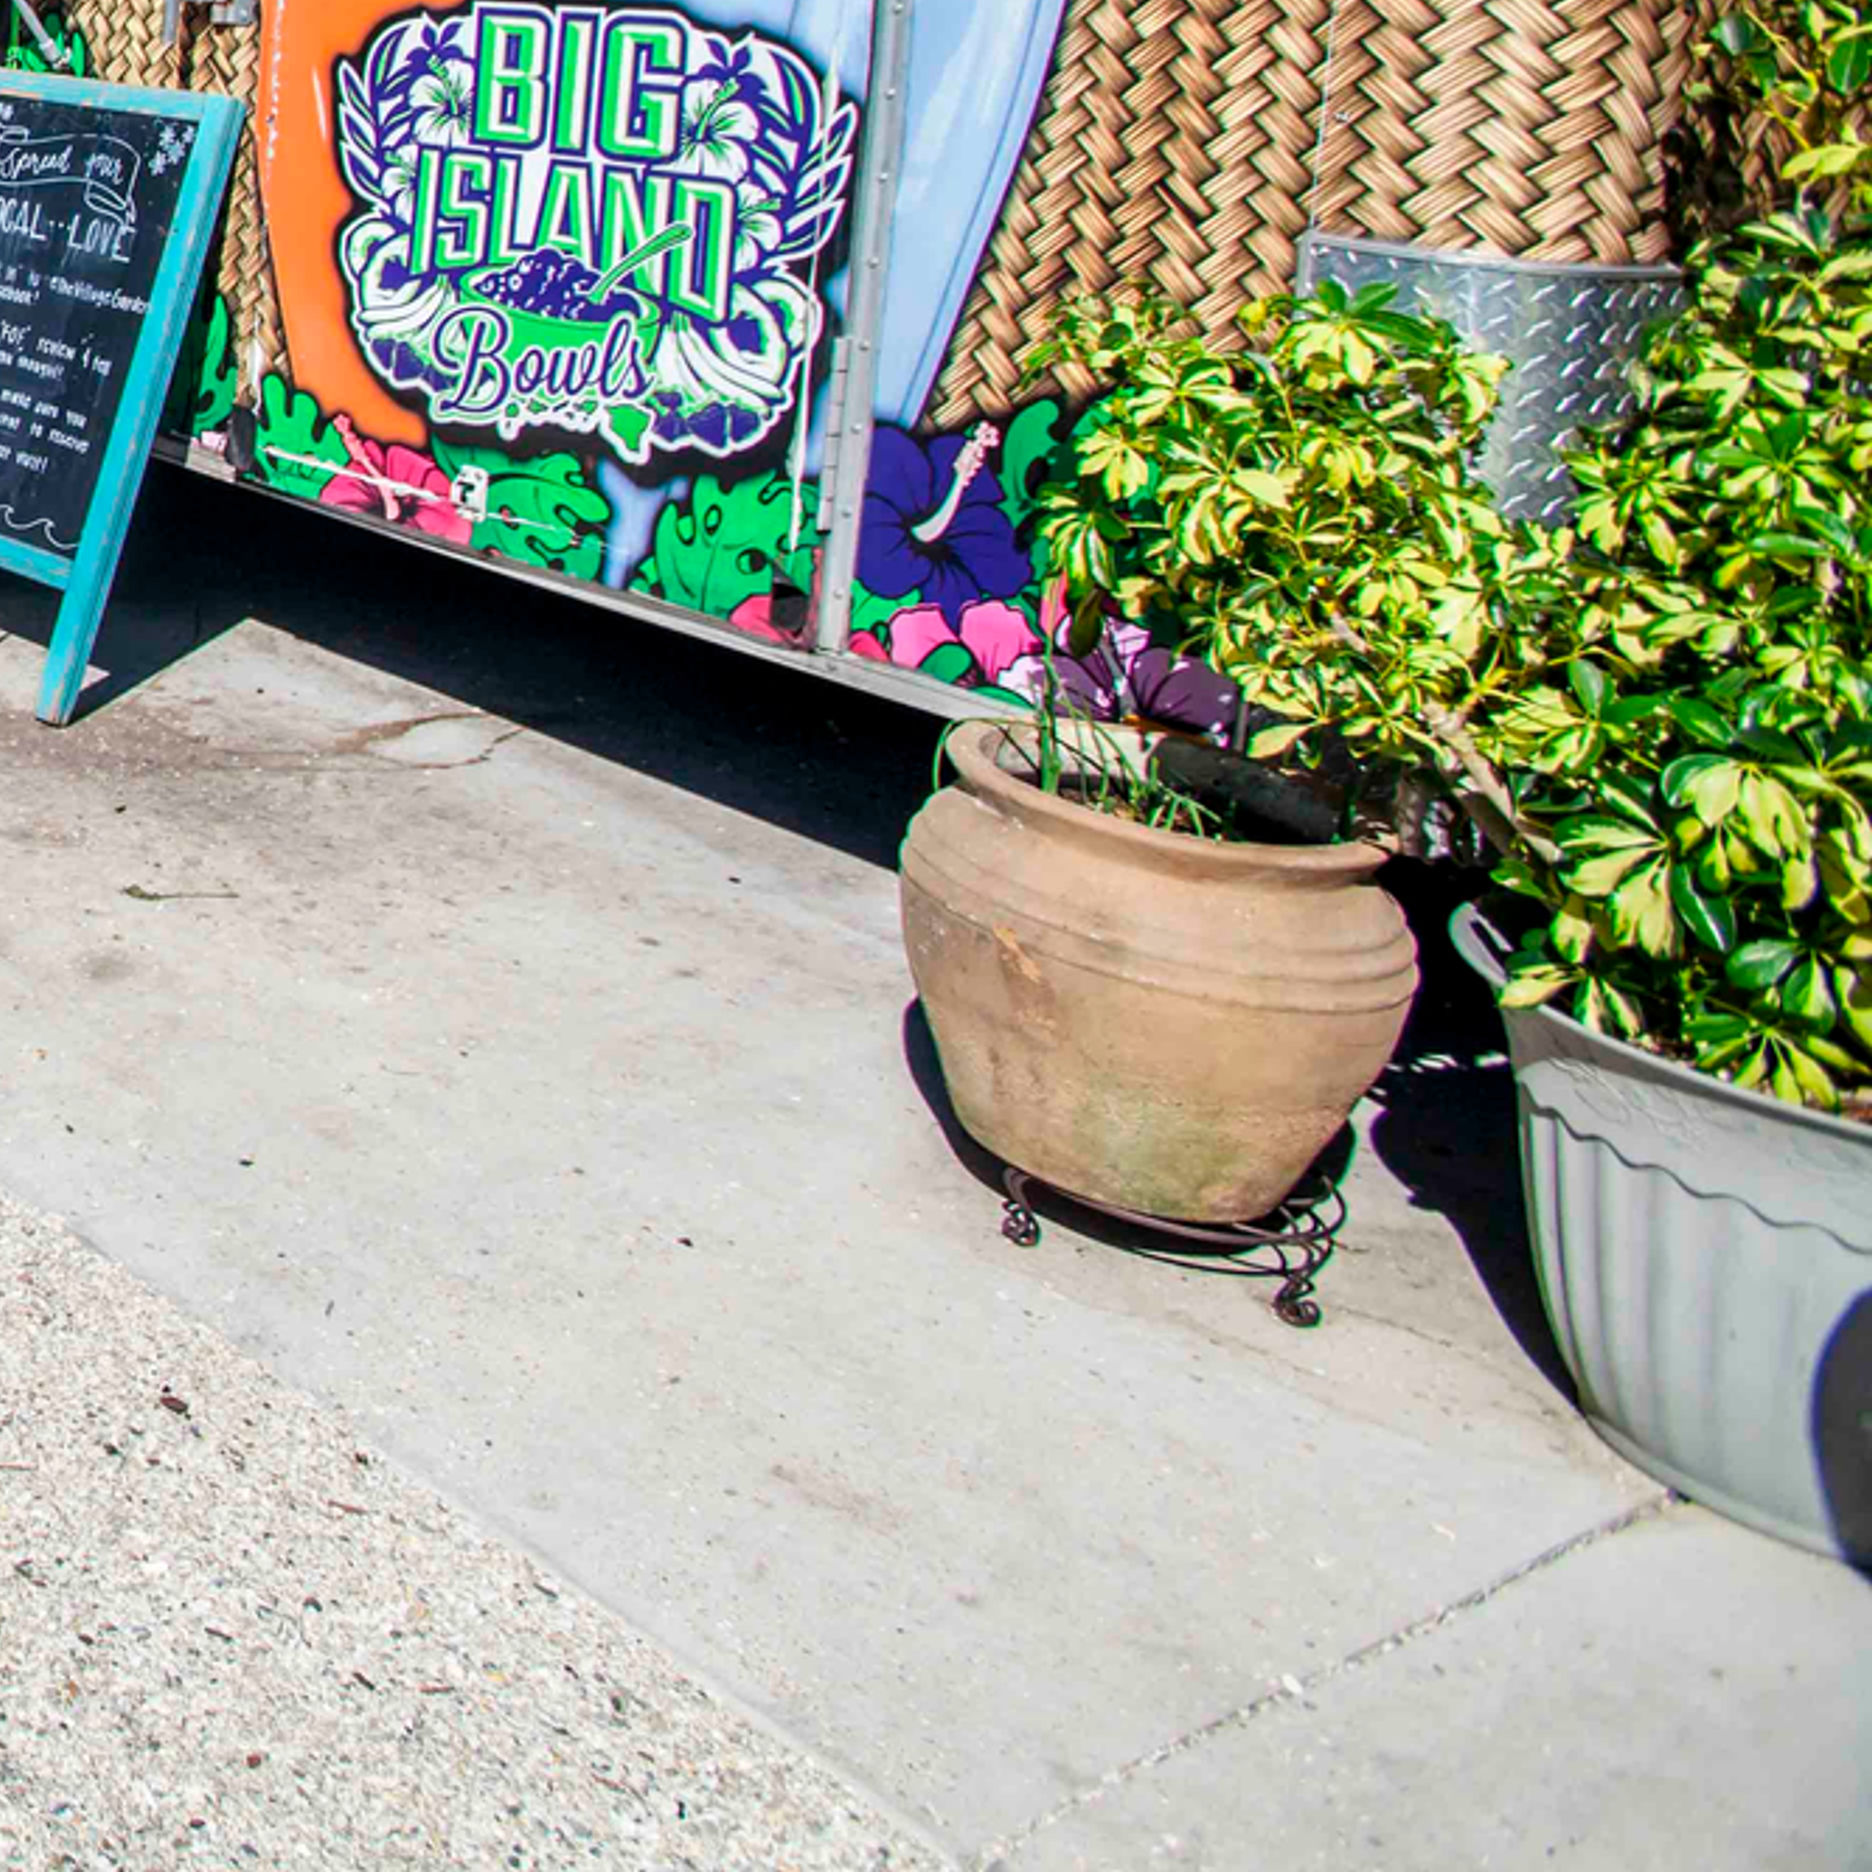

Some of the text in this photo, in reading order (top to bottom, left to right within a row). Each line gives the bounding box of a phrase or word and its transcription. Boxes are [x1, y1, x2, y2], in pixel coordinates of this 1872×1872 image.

[474, 8, 686, 162] BIG
[68, 214, 136, 262] LOVE
[410, 144, 736, 323] ISLAND
[432, 306, 655, 412] Bowls
